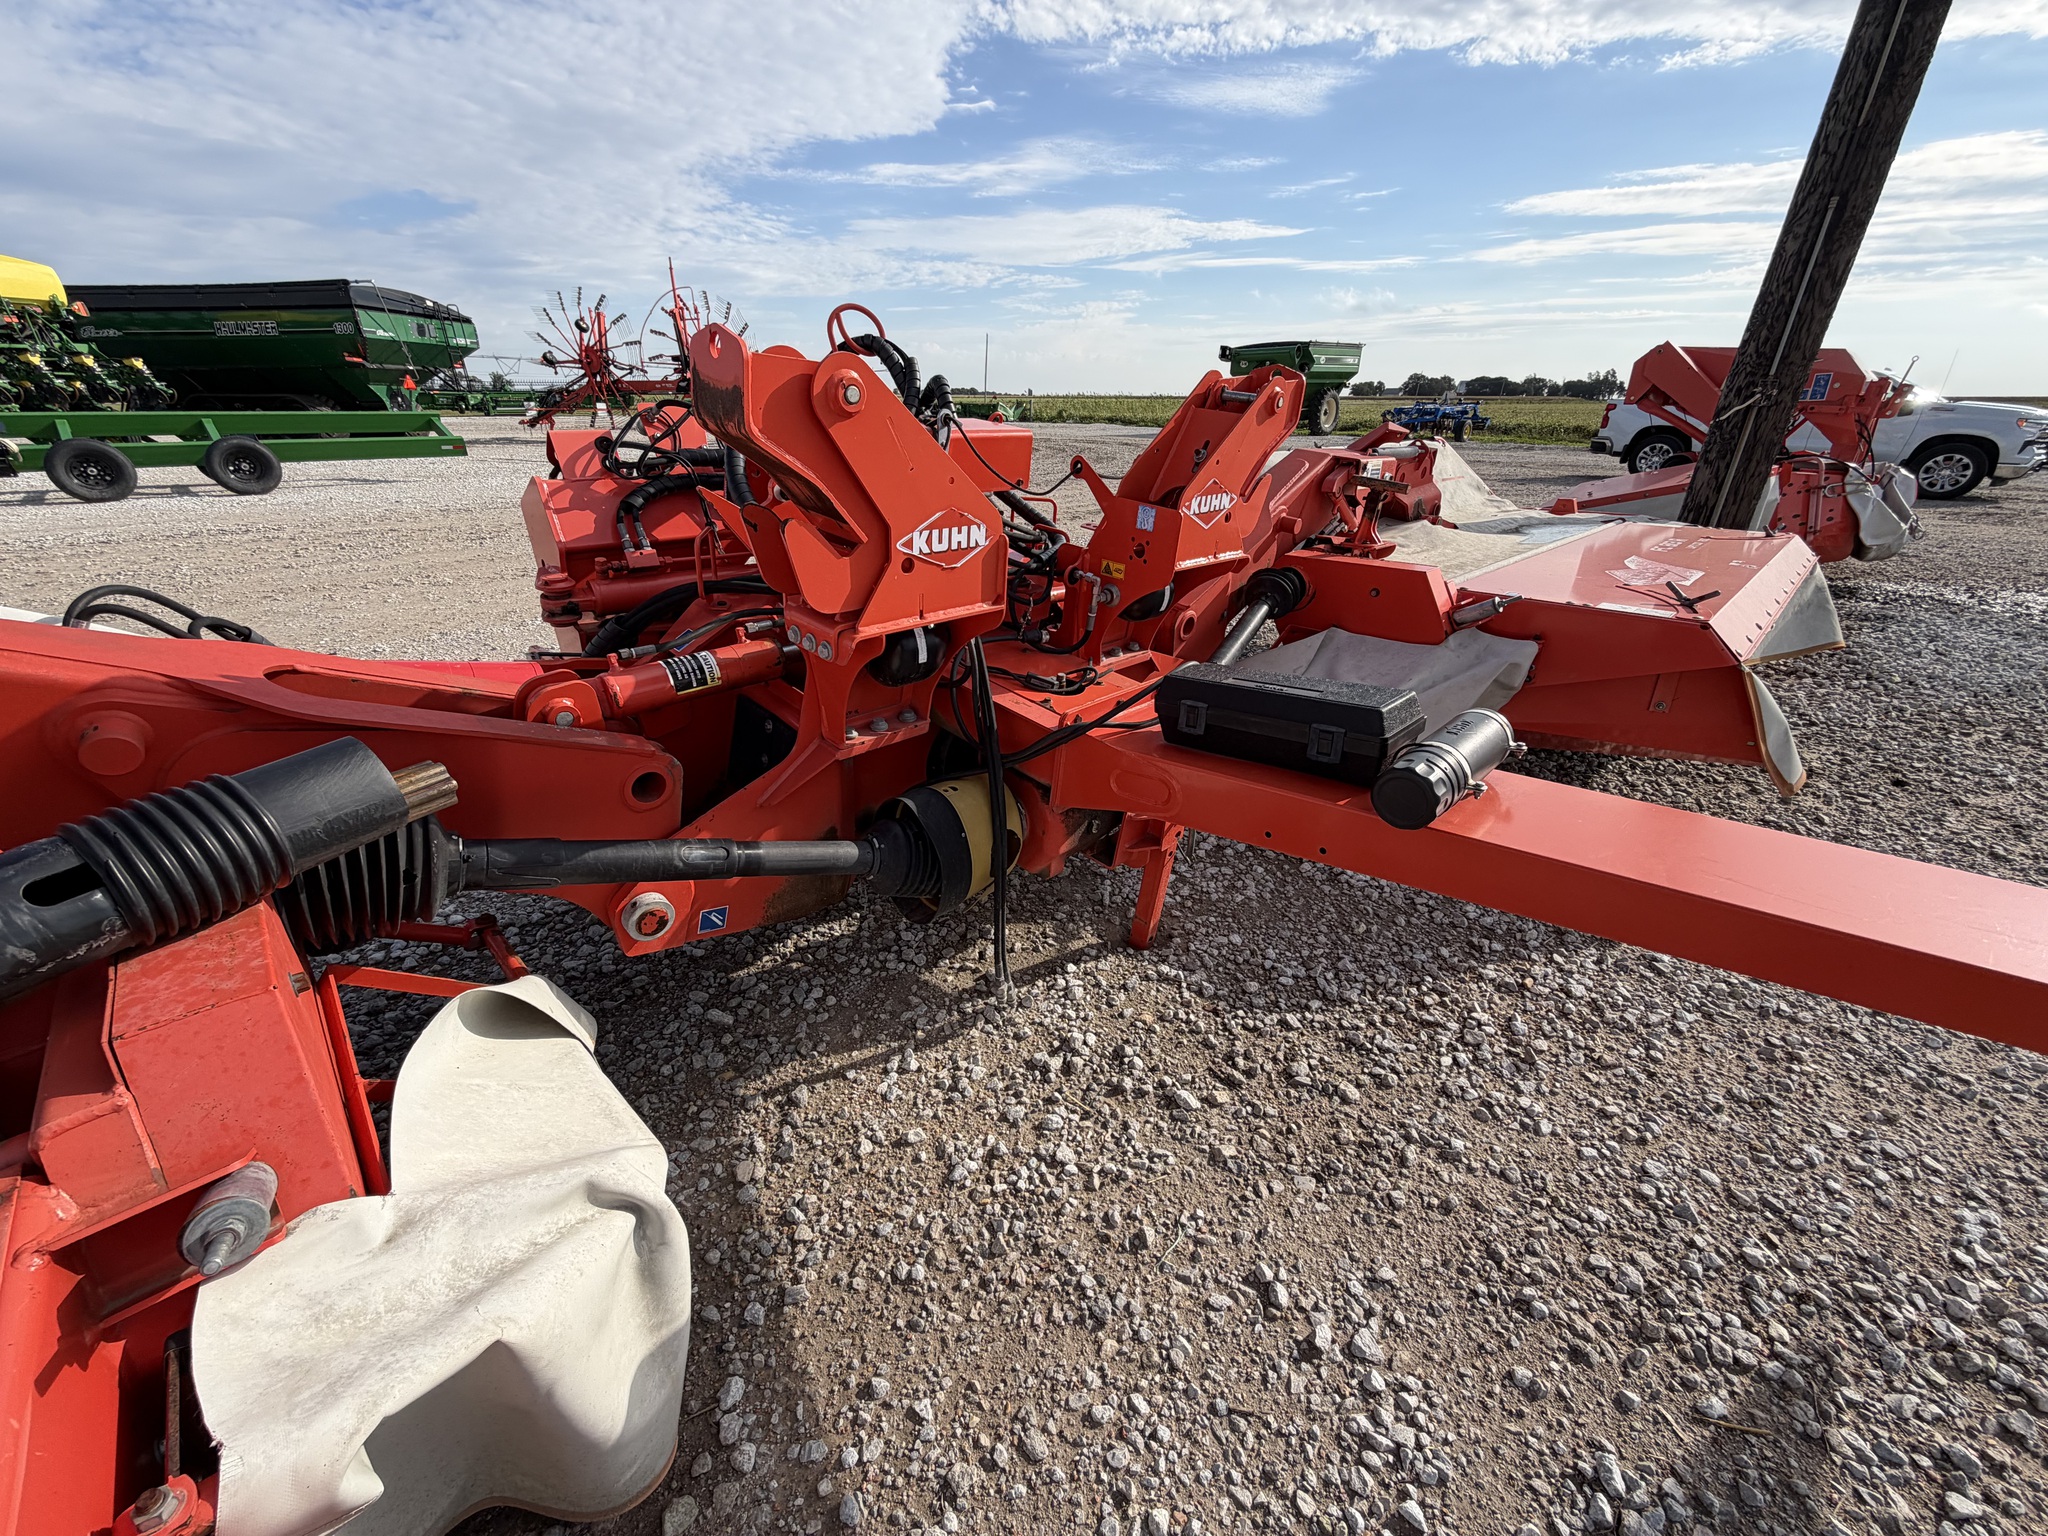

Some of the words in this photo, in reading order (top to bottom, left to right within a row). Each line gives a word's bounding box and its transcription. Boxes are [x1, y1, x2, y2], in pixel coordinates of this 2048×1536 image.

[214, 321, 279, 336] HAULMASTER
[333, 322, 355, 334] 1300
[1190, 492, 1231, 515] KUHN
[912, 524, 986, 555] KUHN
[699, 654, 716, 683] CAUTION
